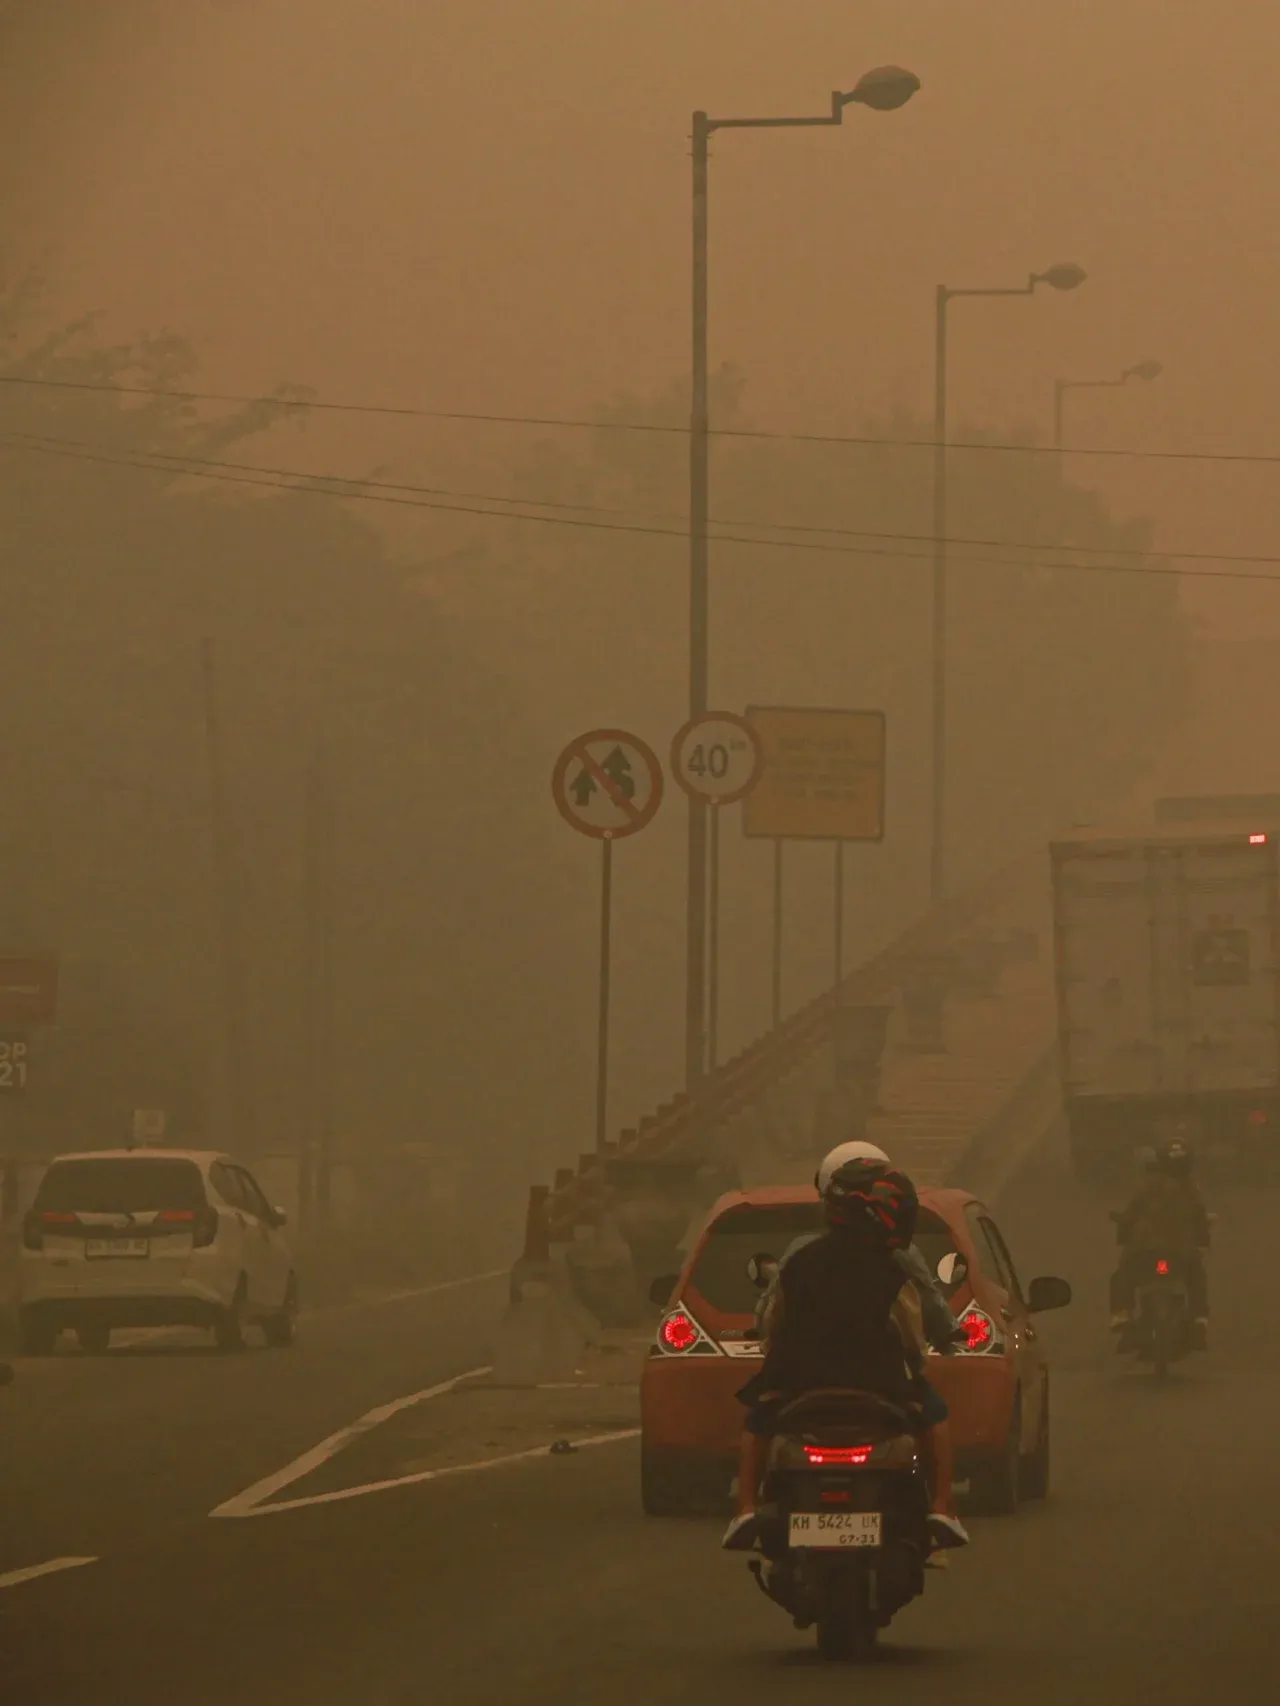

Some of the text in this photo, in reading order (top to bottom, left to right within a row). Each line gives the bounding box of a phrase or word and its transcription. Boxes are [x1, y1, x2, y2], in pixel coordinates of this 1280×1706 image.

[688, 743, 728, 778] 40
[792, 1515, 810, 1530] KH
[817, 1515, 852, 1530] 5424
